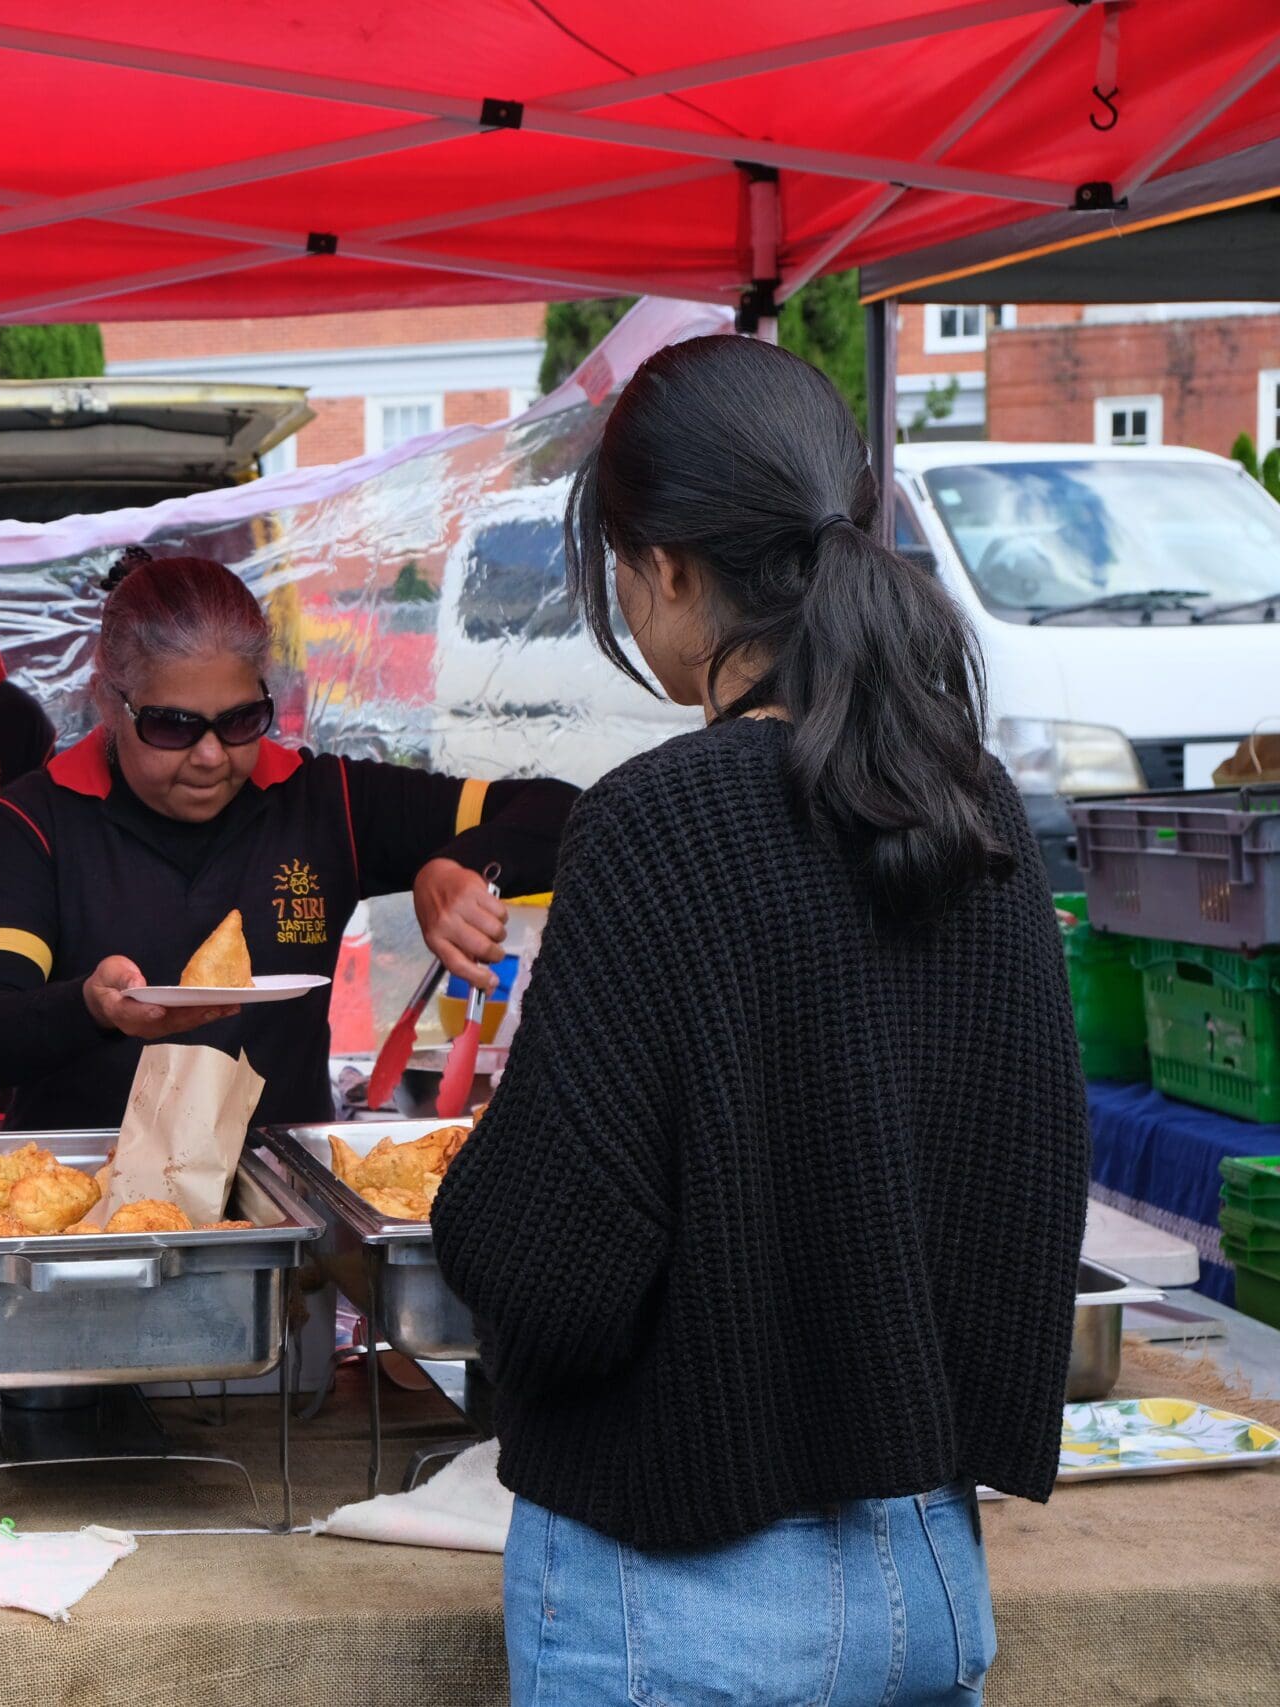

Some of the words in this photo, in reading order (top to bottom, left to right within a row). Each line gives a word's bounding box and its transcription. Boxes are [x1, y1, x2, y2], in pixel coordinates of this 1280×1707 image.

[272, 898, 285, 919] 7
[291, 898, 325, 919] SIRI
[277, 920, 314, 932] TASTE
[315, 920, 326, 931] OF
[277, 931, 297, 943] SRI
[299, 932, 328, 944] LANKA
